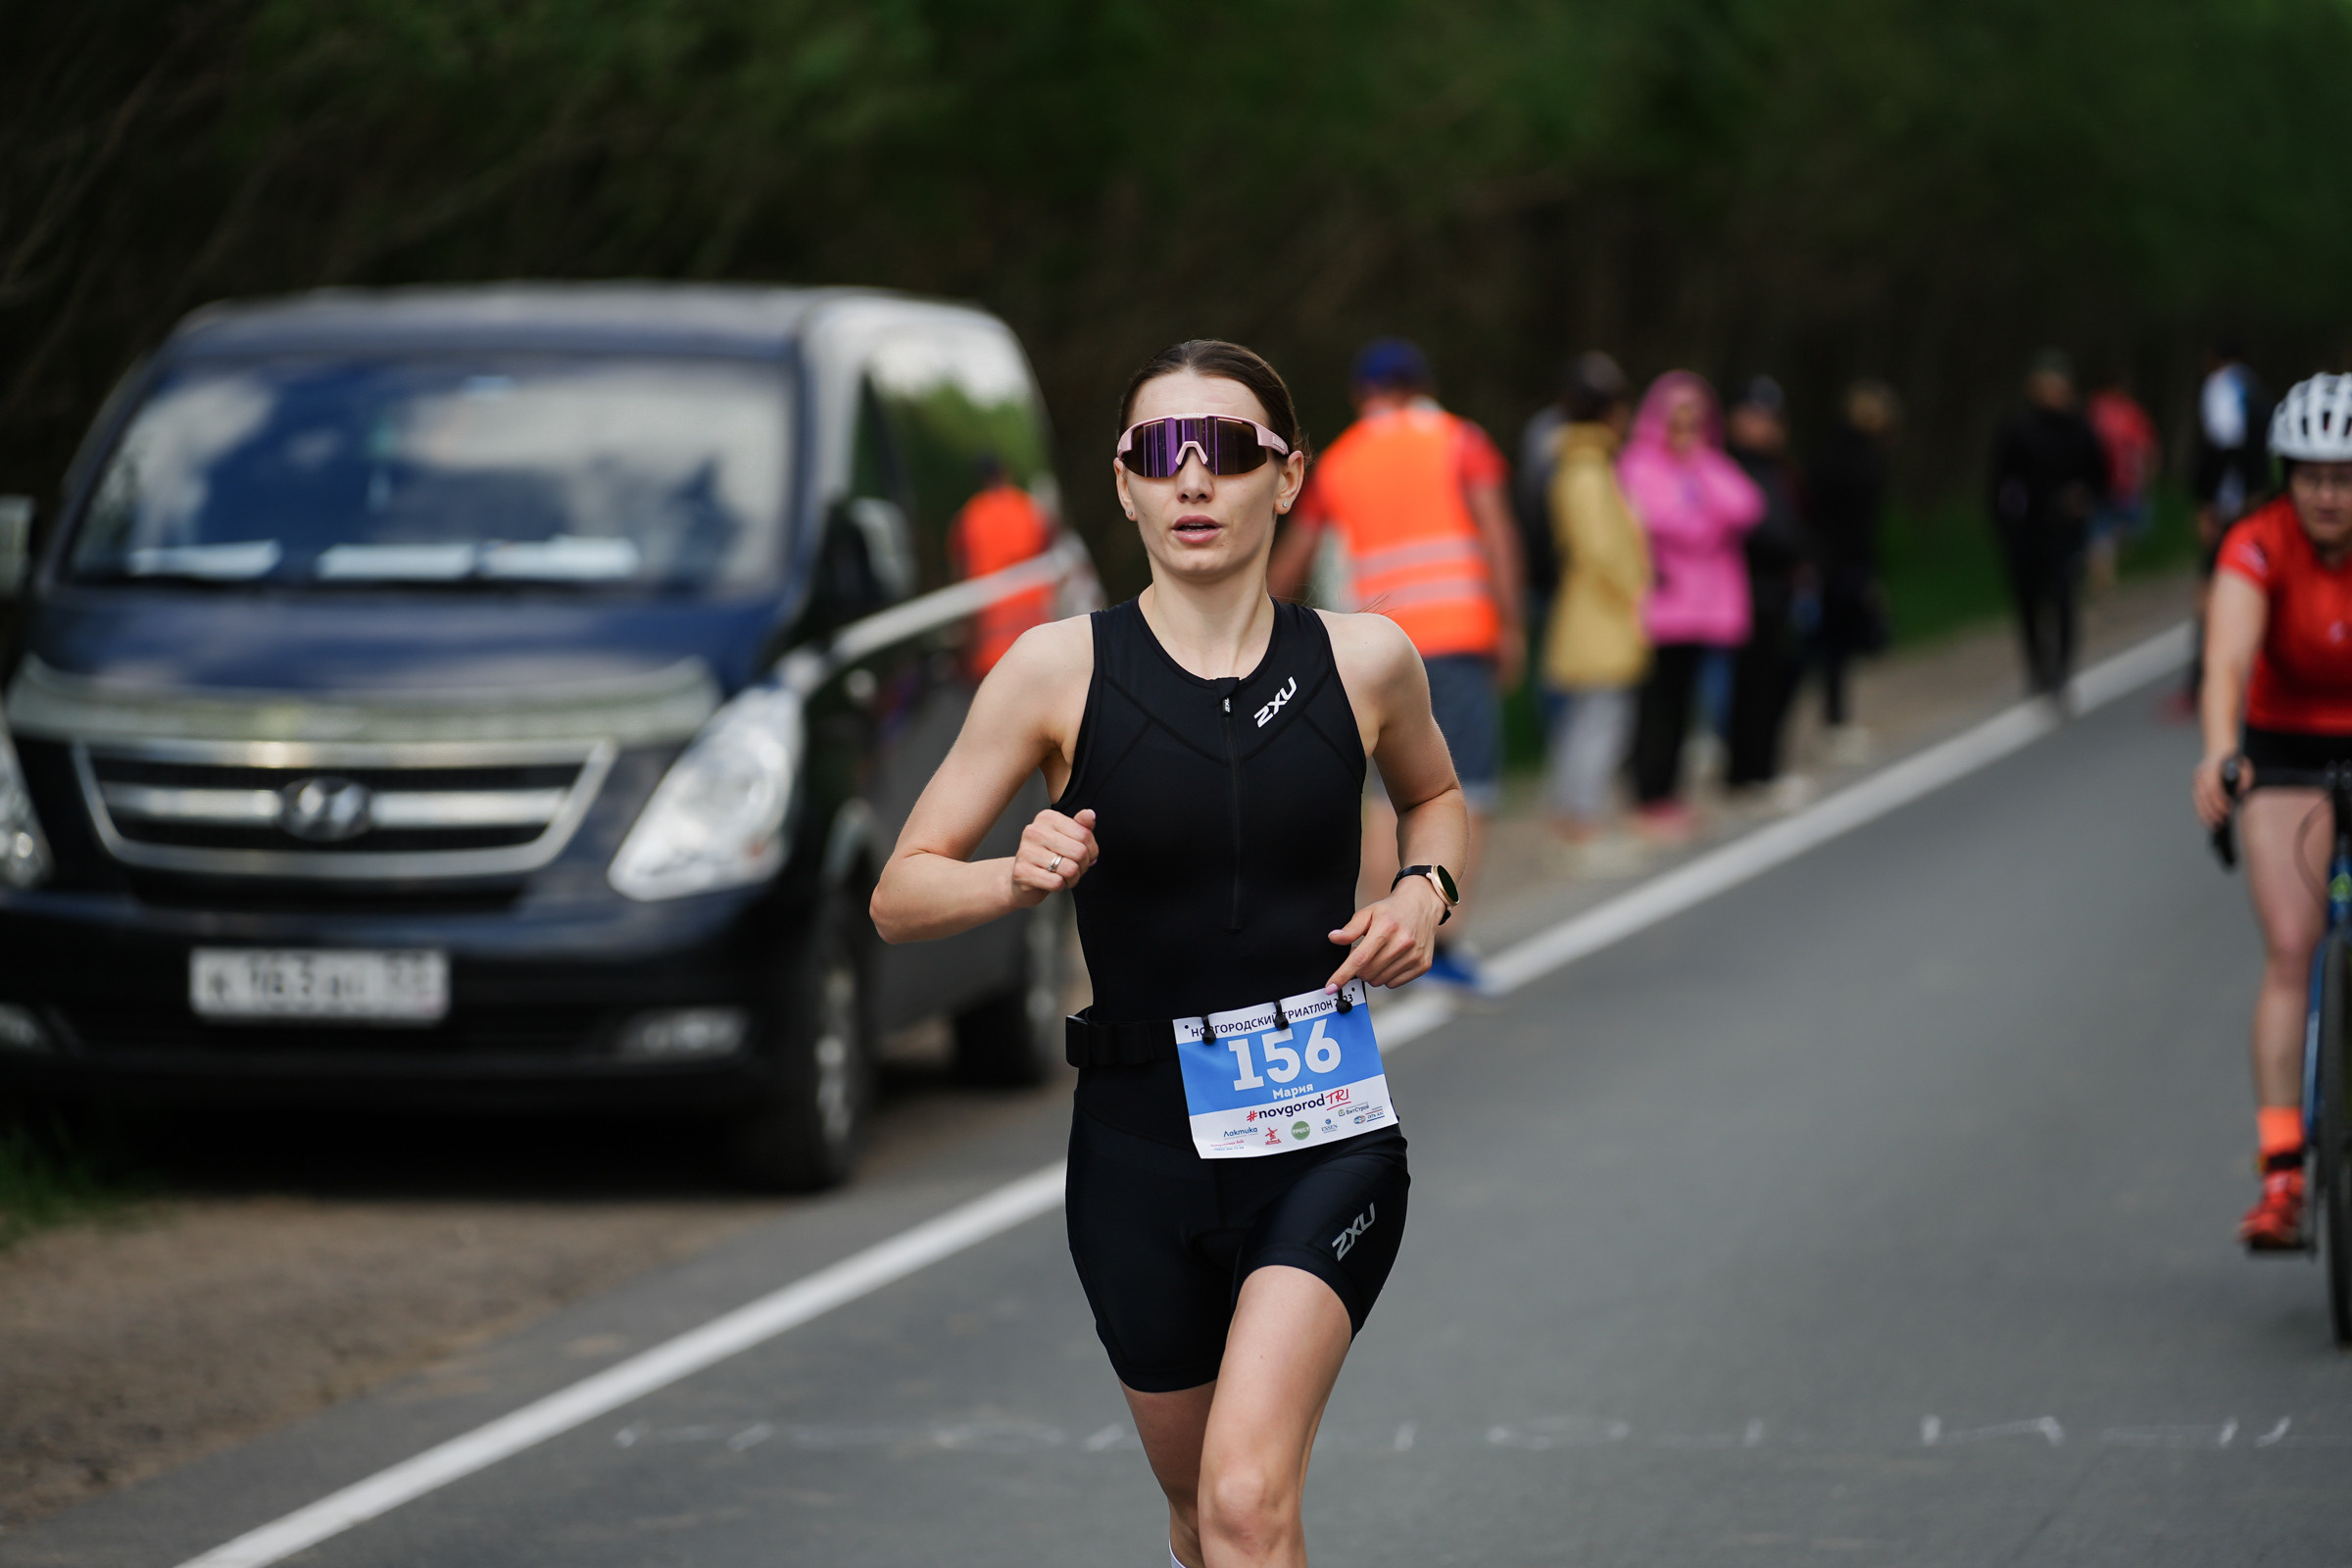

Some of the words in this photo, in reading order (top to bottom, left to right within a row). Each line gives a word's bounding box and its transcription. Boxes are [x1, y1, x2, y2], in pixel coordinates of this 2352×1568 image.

[1253, 676, 1297, 728] 2XU
[1282, 1000, 1334, 1020] ТРИАТЛОН
[1228, 1018, 1342, 1091] 156
[1273, 1083, 1314, 1100] Мария
[1332, 1201, 1375, 1261] 2XU
